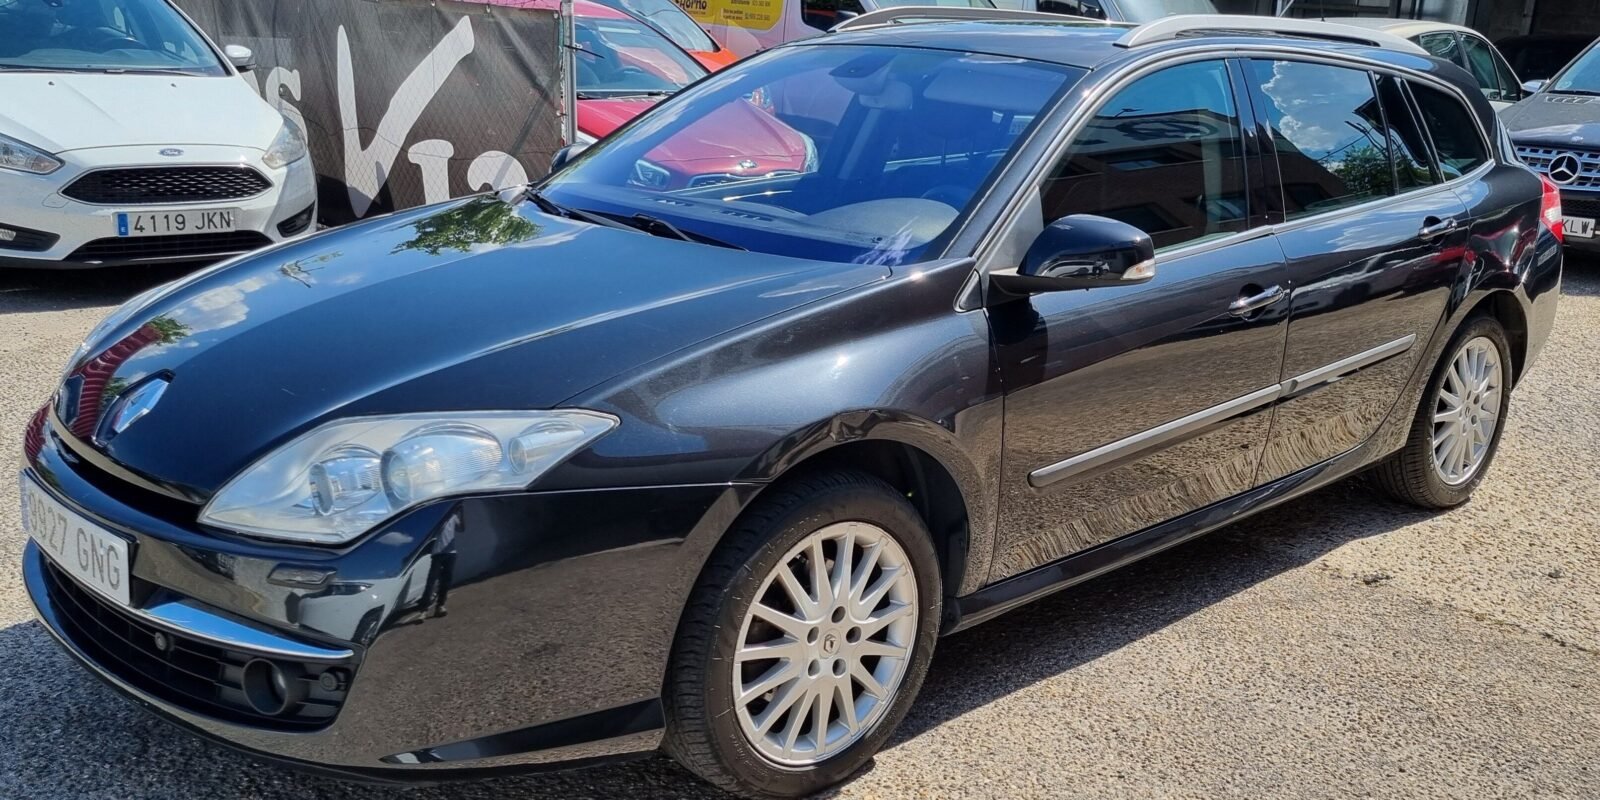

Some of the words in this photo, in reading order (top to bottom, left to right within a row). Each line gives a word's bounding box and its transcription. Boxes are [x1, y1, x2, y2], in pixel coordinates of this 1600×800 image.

[134, 213, 186, 233] 4119
[195, 210, 232, 231] JKN
[28, 492, 68, 556] 9927
[76, 527, 121, 591] GNG
